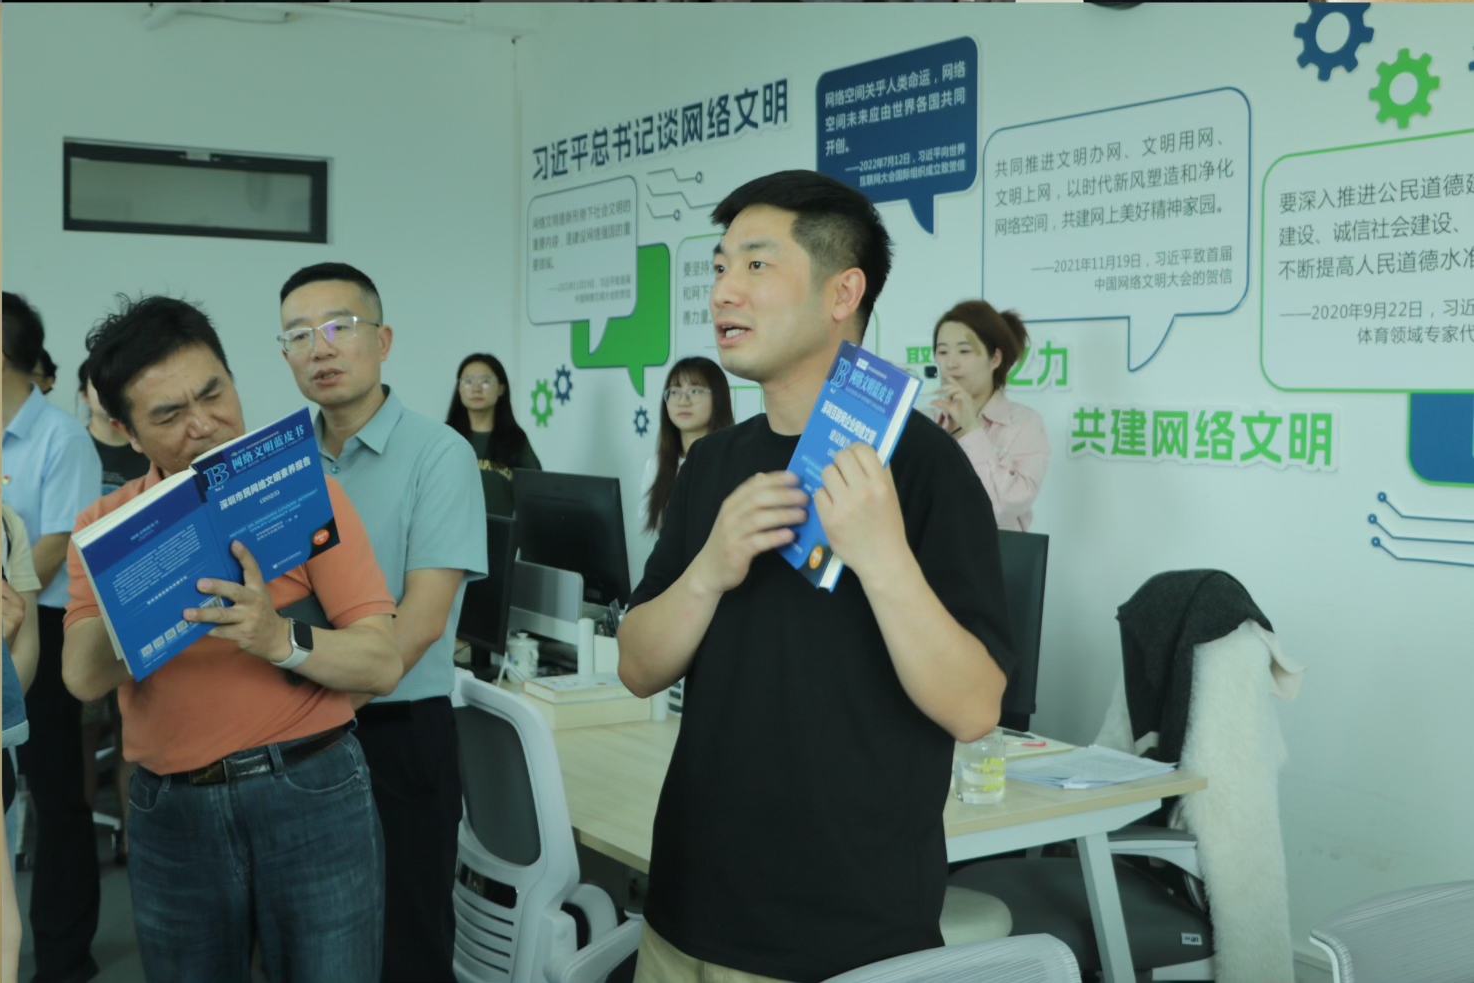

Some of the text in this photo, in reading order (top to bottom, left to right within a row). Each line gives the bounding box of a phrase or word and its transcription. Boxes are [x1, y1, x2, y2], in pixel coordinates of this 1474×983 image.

[532, 78, 788, 181] 习近平总书记谈网络文明
[825, 87, 966, 133] 空间未来应由世界各国共同
[683, 285, 713, 302] 和网下
[1094, 268, 1233, 293] 中国网络文明大会的贺信
[1357, 324, 1474, 346] 体育领域专家代
[231, 424, 305, 471] 网络文明蓝皮书
[1070, 406, 1334, 466] 共建网络文明
[203, 462, 230, 490] B
[219, 456, 312, 511] 深圳市民网络文明素养报告
